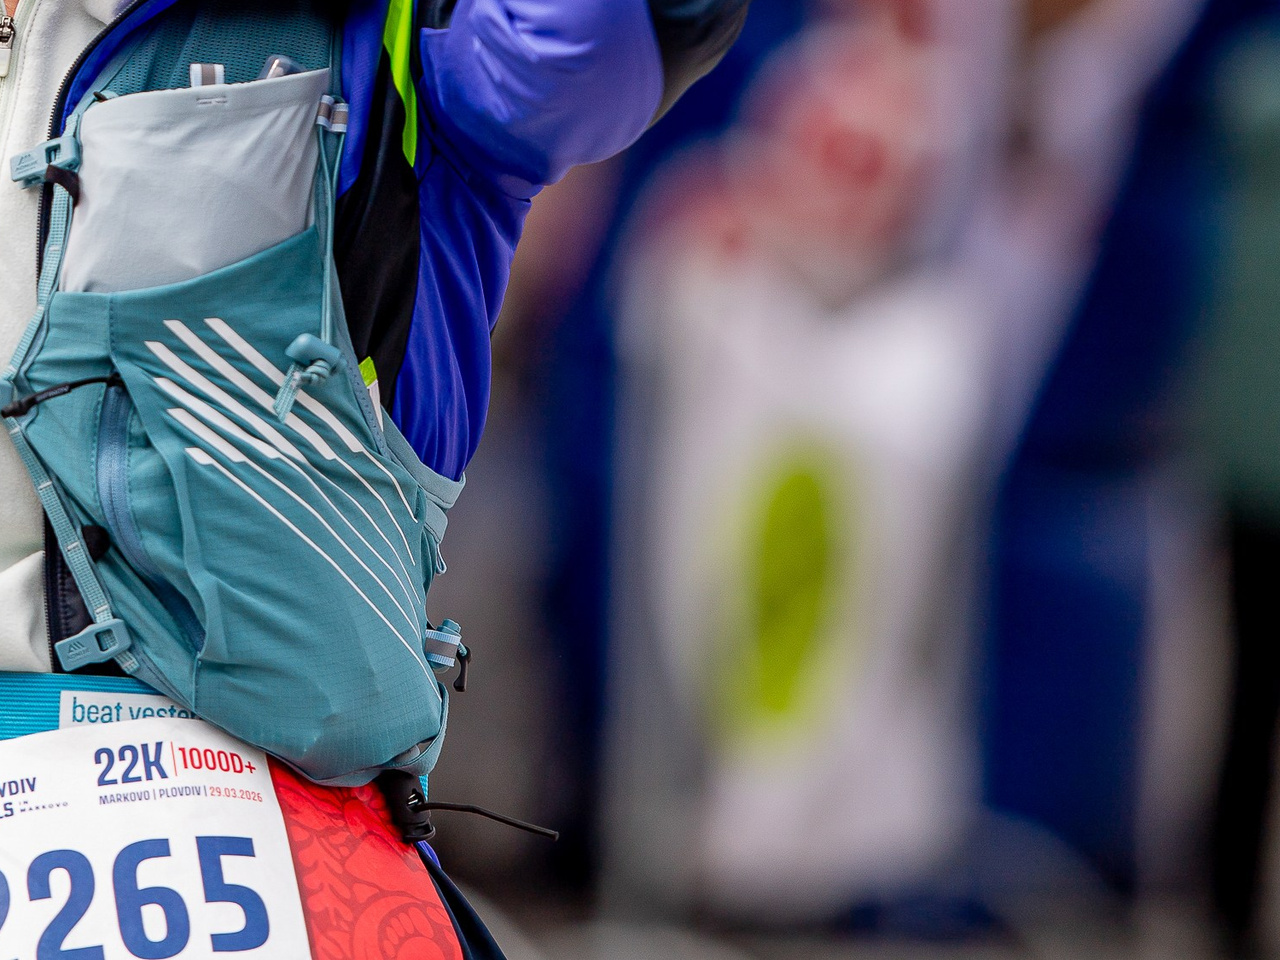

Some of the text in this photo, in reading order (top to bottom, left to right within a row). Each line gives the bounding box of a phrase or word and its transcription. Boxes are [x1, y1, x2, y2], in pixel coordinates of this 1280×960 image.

[72, 697, 122, 723] beat
[94, 741, 256, 786] 22K 1000D+
[99, 785, 263, 805] MARKOVO PLOVDIV 29.03.2026
